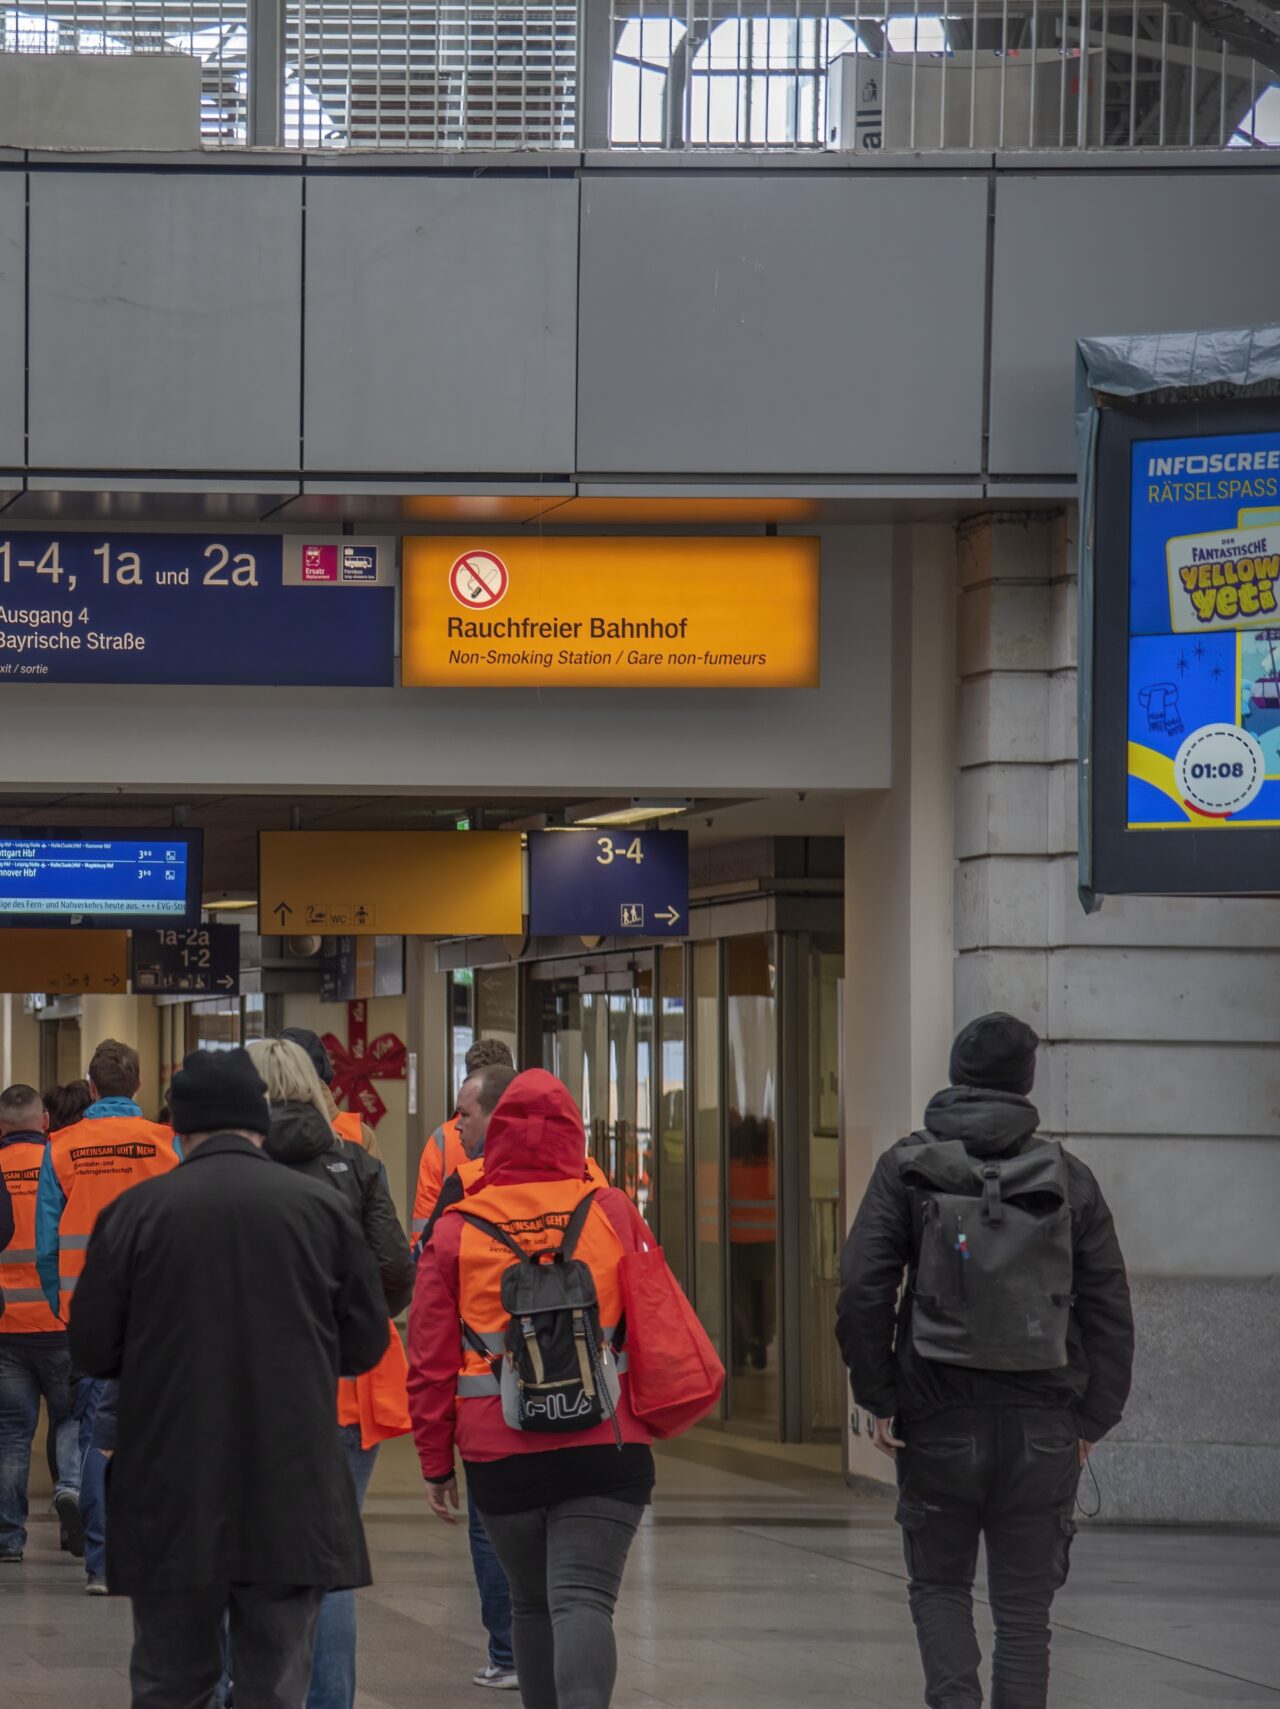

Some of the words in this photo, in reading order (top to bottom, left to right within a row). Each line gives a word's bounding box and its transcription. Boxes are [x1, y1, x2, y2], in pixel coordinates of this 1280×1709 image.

[1148, 478, 1278, 503] RÄTSELSPASS
[1192, 538, 1267, 562] FANTASTISCHE
[93, 542, 143, 586] 1a
[155, 568, 189, 586] und
[203, 543, 259, 587] 2a
[1179, 554, 1280, 593] YELLOW
[78, 607, 90, 624] 4
[447, 616, 583, 639] Rauchfreier
[589, 617, 688, 639] Bahnhof
[87, 632, 146, 651] Straße
[449, 650, 553, 668] Non-Smoking
[558, 650, 612, 665] Station
[627, 650, 664, 666] Gare
[667, 650, 767, 666] non-fumeurs
[20, 663, 49, 675] sortie
[1191, 763, 1244, 779] 01:08
[22, 849, 36, 857] Hbf
[596, 837, 644, 865] 3-4
[23, 868, 36, 877] Hbf
[12, 900, 25, 908] des
[26, 900, 45, 909] Fern-
[46, 900, 59, 909] und
[60, 901, 103, 910] Nahverkehrs
[104, 901, 125, 910] heute
[331, 915, 347, 923] WC
[156, 929, 210, 945] 1a-2a
[180, 949, 210, 967] 1-2
[72, 1146, 113, 1159] GEMEINSAM
[116, 1145, 134, 1155] GEHT
[136, 1145, 155, 1155] MEHR
